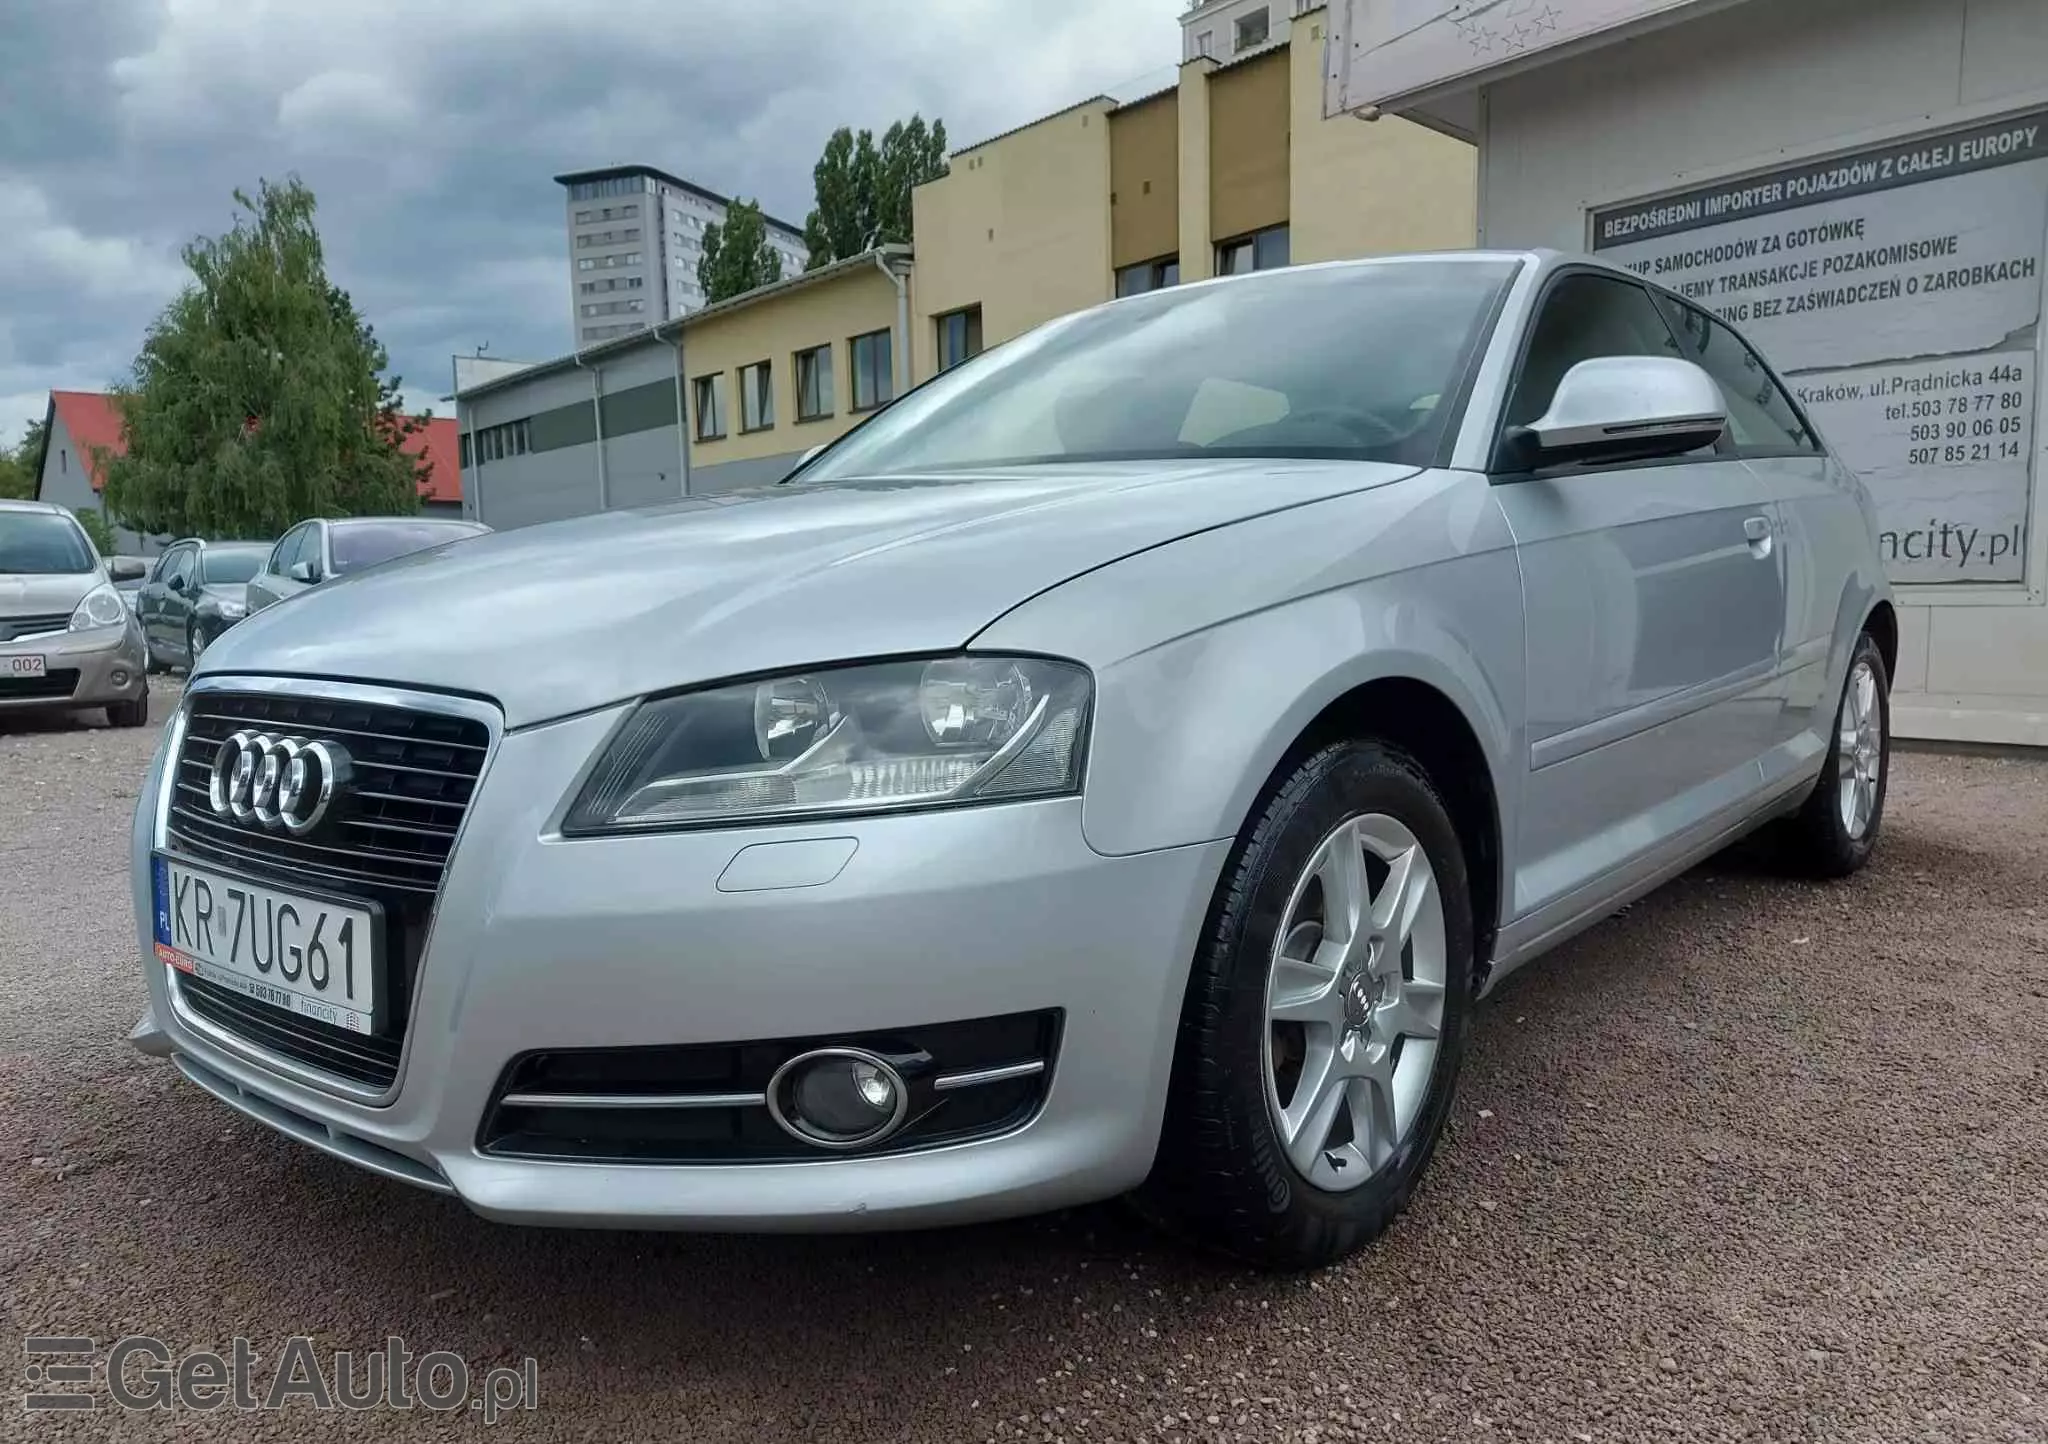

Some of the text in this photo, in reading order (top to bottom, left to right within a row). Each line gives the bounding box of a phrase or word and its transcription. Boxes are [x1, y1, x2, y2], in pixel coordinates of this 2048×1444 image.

[1604, 126, 2039, 239] BEZPOŚREDNI IMPORTER POJAZDÓW Z CAŁEJ EUROPY
[1655, 239, 1758, 274] SAMOCHODÓW
[1761, 236, 1782, 253] ZA
[1786, 218, 1866, 249] GOTÓWKĘ
[1719, 262, 1819, 294] TRANSAKCJE
[1823, 236, 1959, 274] POZAKOMISOWE
[1753, 299, 1782, 320] BEZ
[1786, 278, 1901, 315] ZAŚWIADCZEŃ
[1905, 277, 1919, 295] O
[1923, 258, 2036, 293] ZAROBKACH
[1870, 370, 1983, 398] ul.Prądnicka
[1989, 364, 2023, 384] 44a
[1885, 391, 2023, 421] tel.503 78 77 80
[1910, 416, 2021, 442] 503 90 06 05
[1909, 441, 2019, 465] 507 85 21 14
[12, 658, 42, 671] 002
[159, 911, 170, 931] PL
[174, 871, 354, 1000] KR 7UG61
